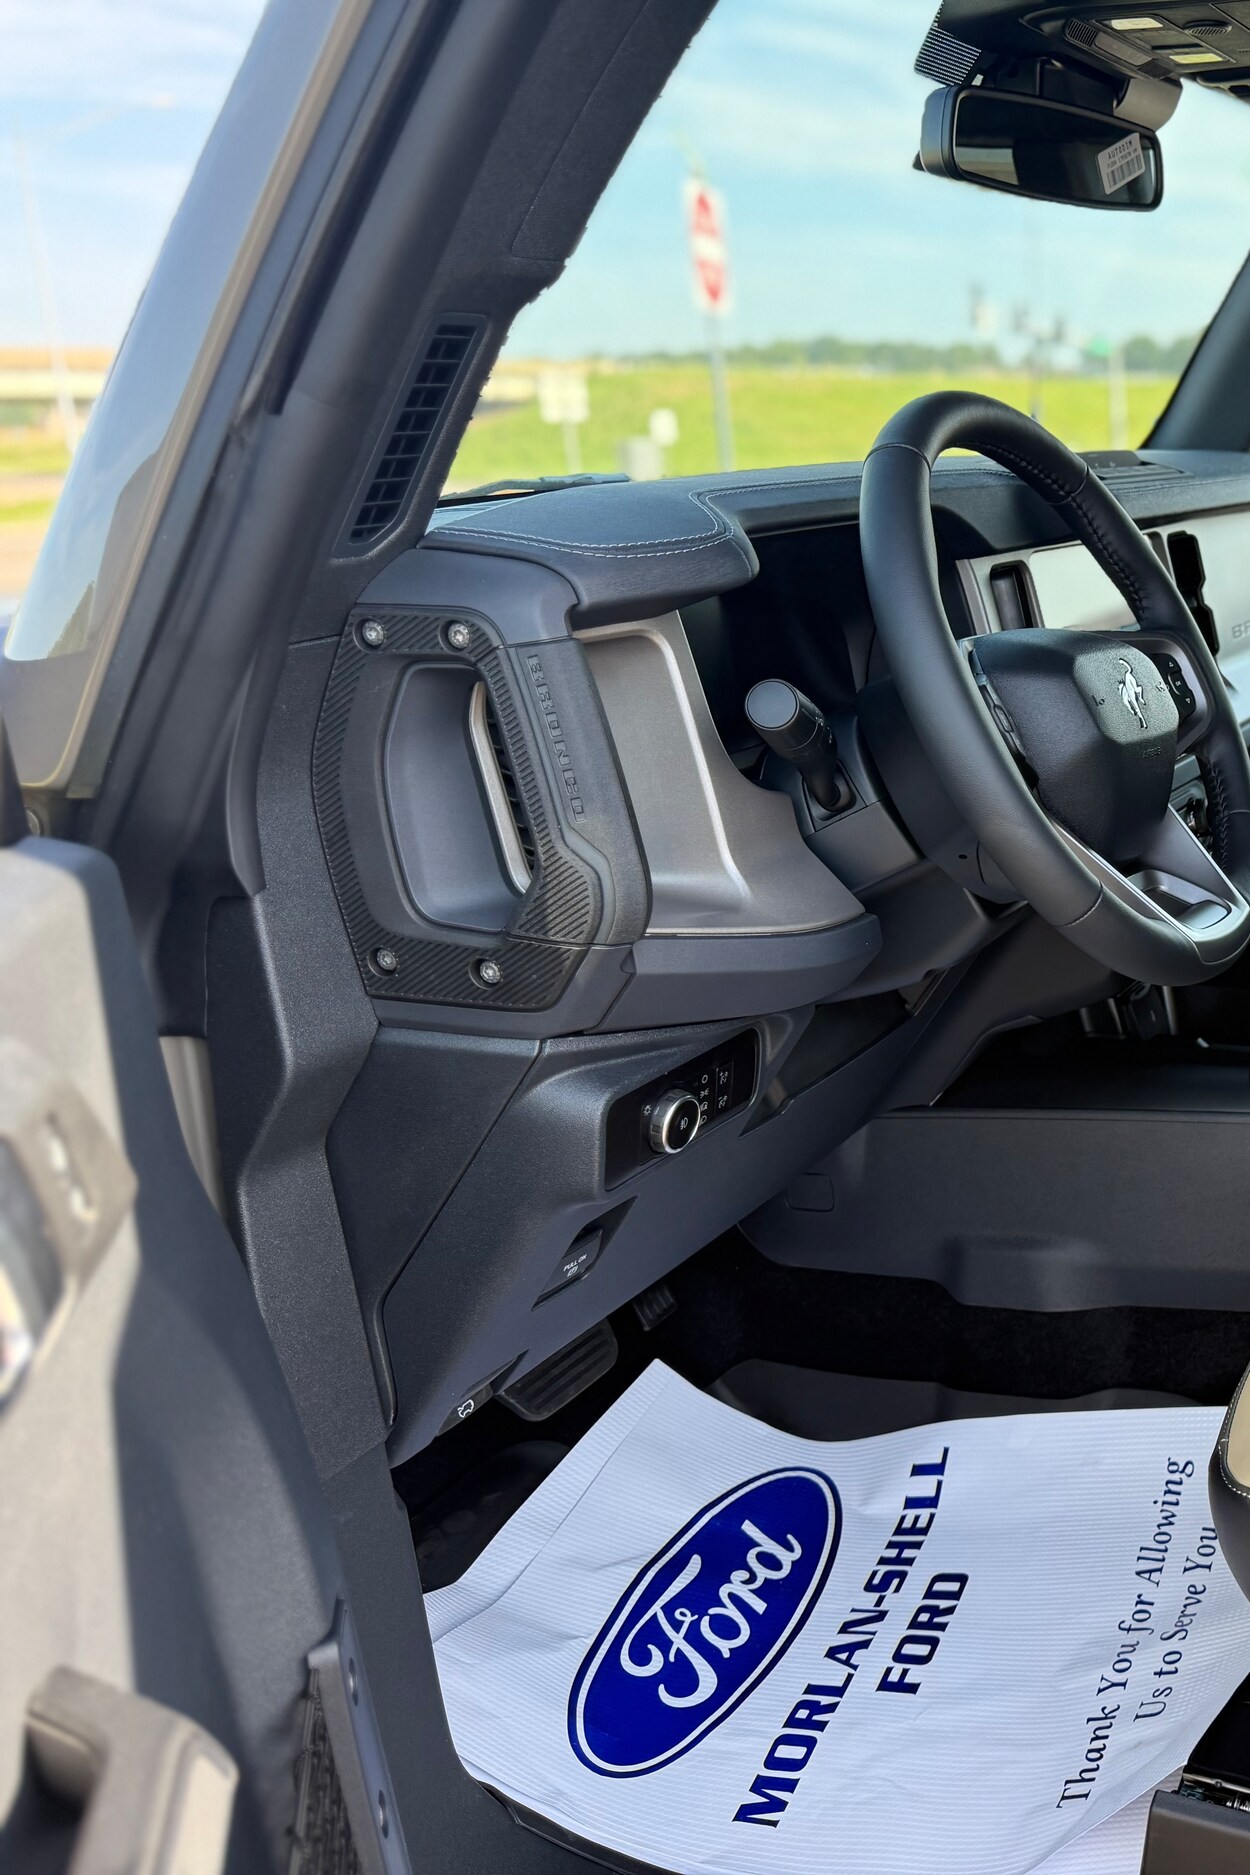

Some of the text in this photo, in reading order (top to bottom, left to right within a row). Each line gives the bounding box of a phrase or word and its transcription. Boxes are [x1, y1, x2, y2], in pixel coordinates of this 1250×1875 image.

[1107, 140, 1133, 160] AUTODIM
[527, 654, 587, 823] BRONCO
[563, 1254, 588, 1271] PULL ON
[620, 1519, 801, 1708] Ford
[731, 1446, 950, 1828] MORLAN-SHELL
[876, 1573, 969, 1696] FORD
[1055, 1456, 1195, 1809] Thank You for Allowing
[1133, 1526, 1218, 1723] Us to Serve You
